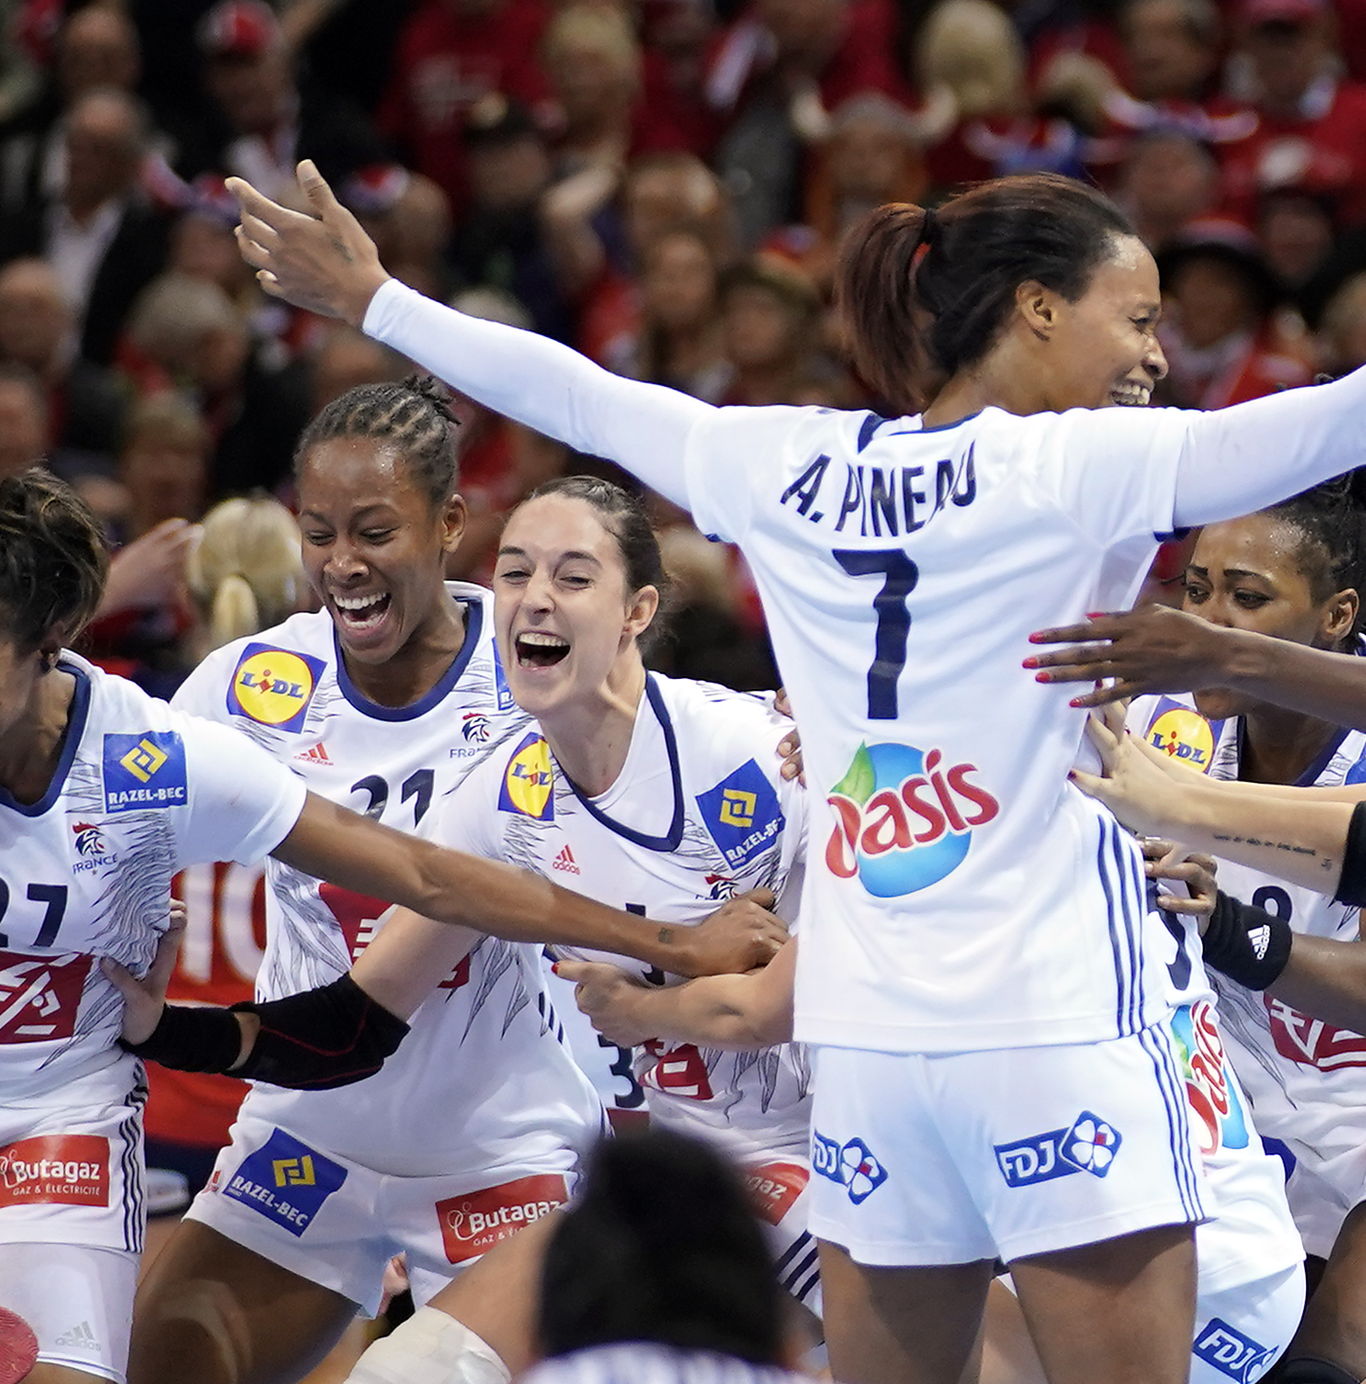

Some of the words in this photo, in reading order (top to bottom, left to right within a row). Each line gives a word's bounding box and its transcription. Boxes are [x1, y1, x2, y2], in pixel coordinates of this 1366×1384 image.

[779, 453, 832, 524] A.
[831, 547, 919, 719] 7
[108, 786, 185, 805] RAZEL-BEC
[825, 747, 1000, 878] Oasis
[12, 1159, 100, 1183] Butagaz
[1001, 1140, 1057, 1180] FDJ
[12, 1185, 31, 1196] GAZ
[231, 1175, 309, 1227] RAZEL-BEC
[1201, 1327, 1257, 1371] FDJ
